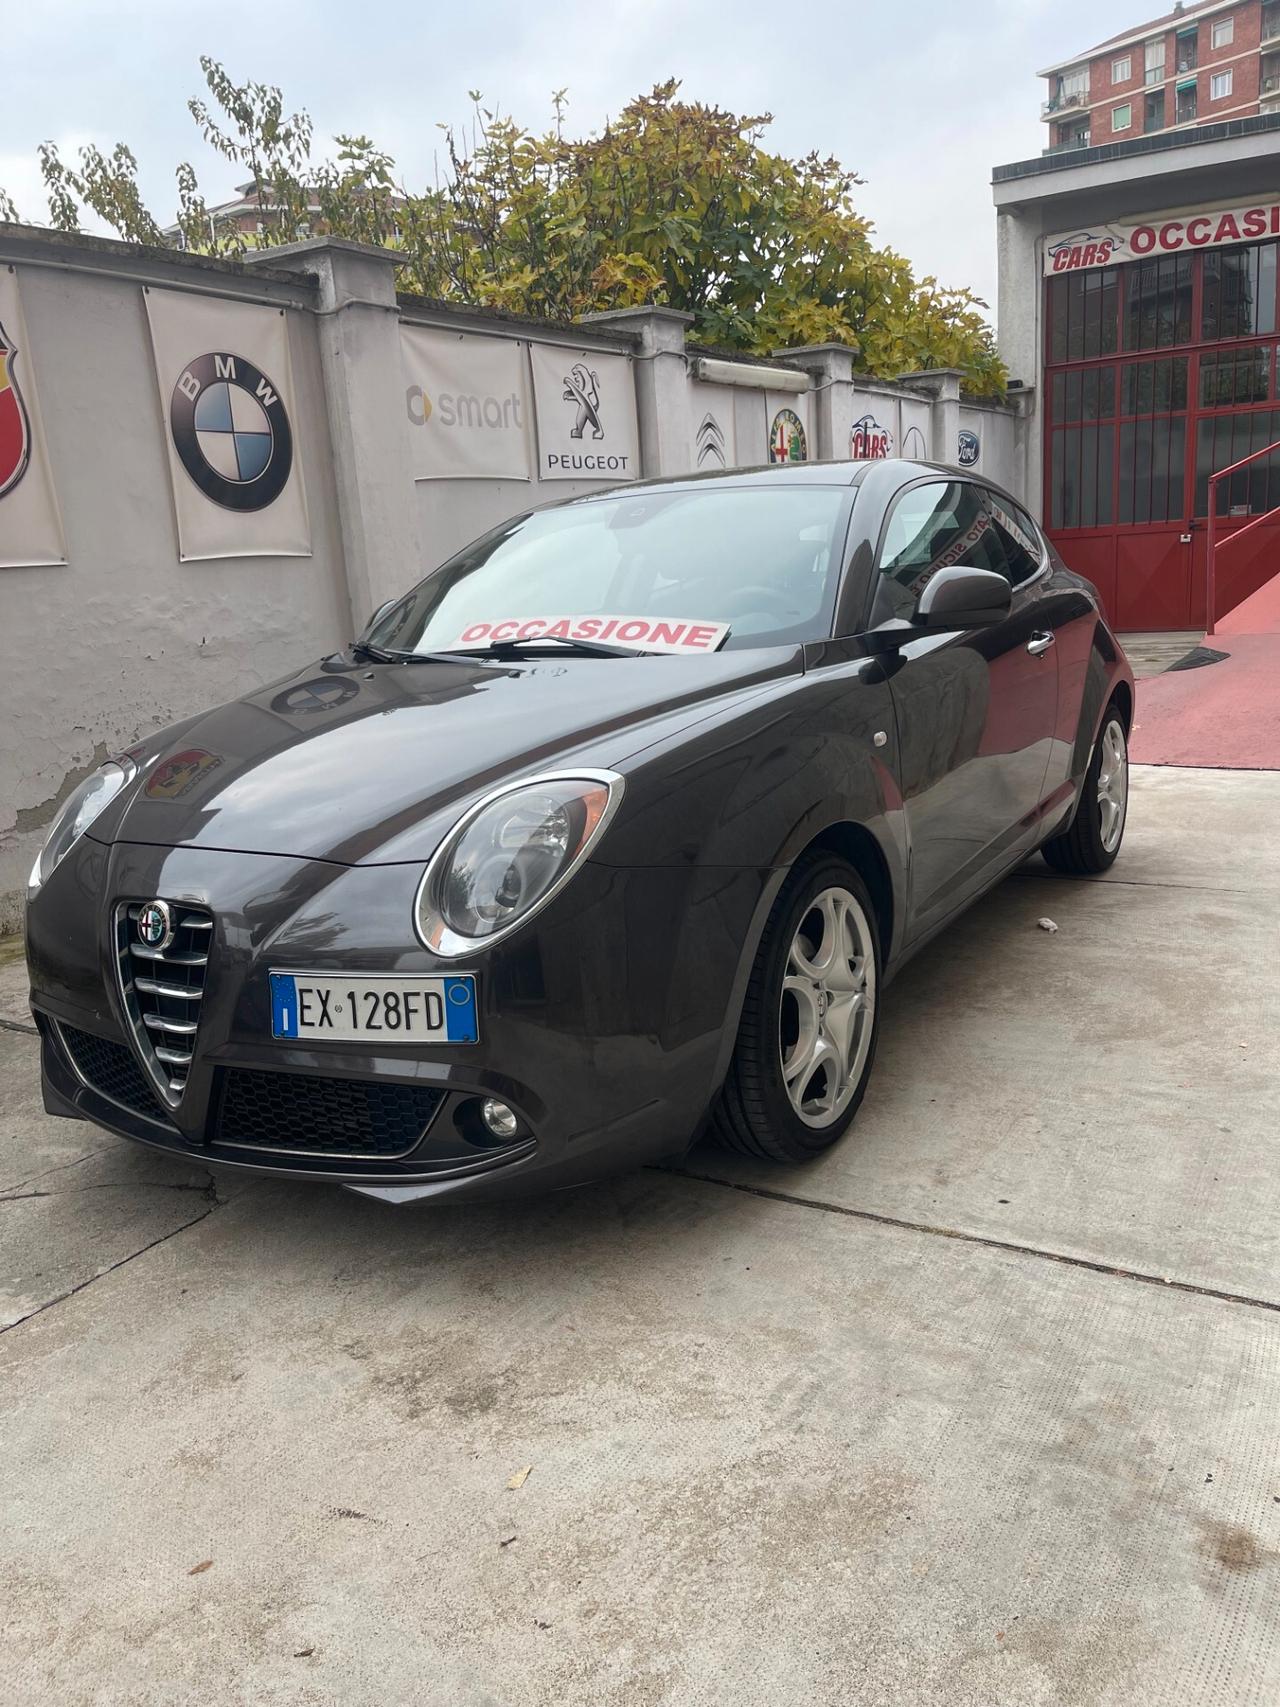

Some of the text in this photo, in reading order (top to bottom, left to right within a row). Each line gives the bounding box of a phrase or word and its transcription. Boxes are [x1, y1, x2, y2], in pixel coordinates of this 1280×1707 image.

[1053, 206, 1280, 272] CARS OCCASI
[177, 355, 278, 407] BMW
[438, 393, 523, 428] smart
[547, 454, 629, 470] PEUGEOT
[460, 619, 721, 648] OCCASIONE
[298, 988, 444, 1031] EX 128FD
